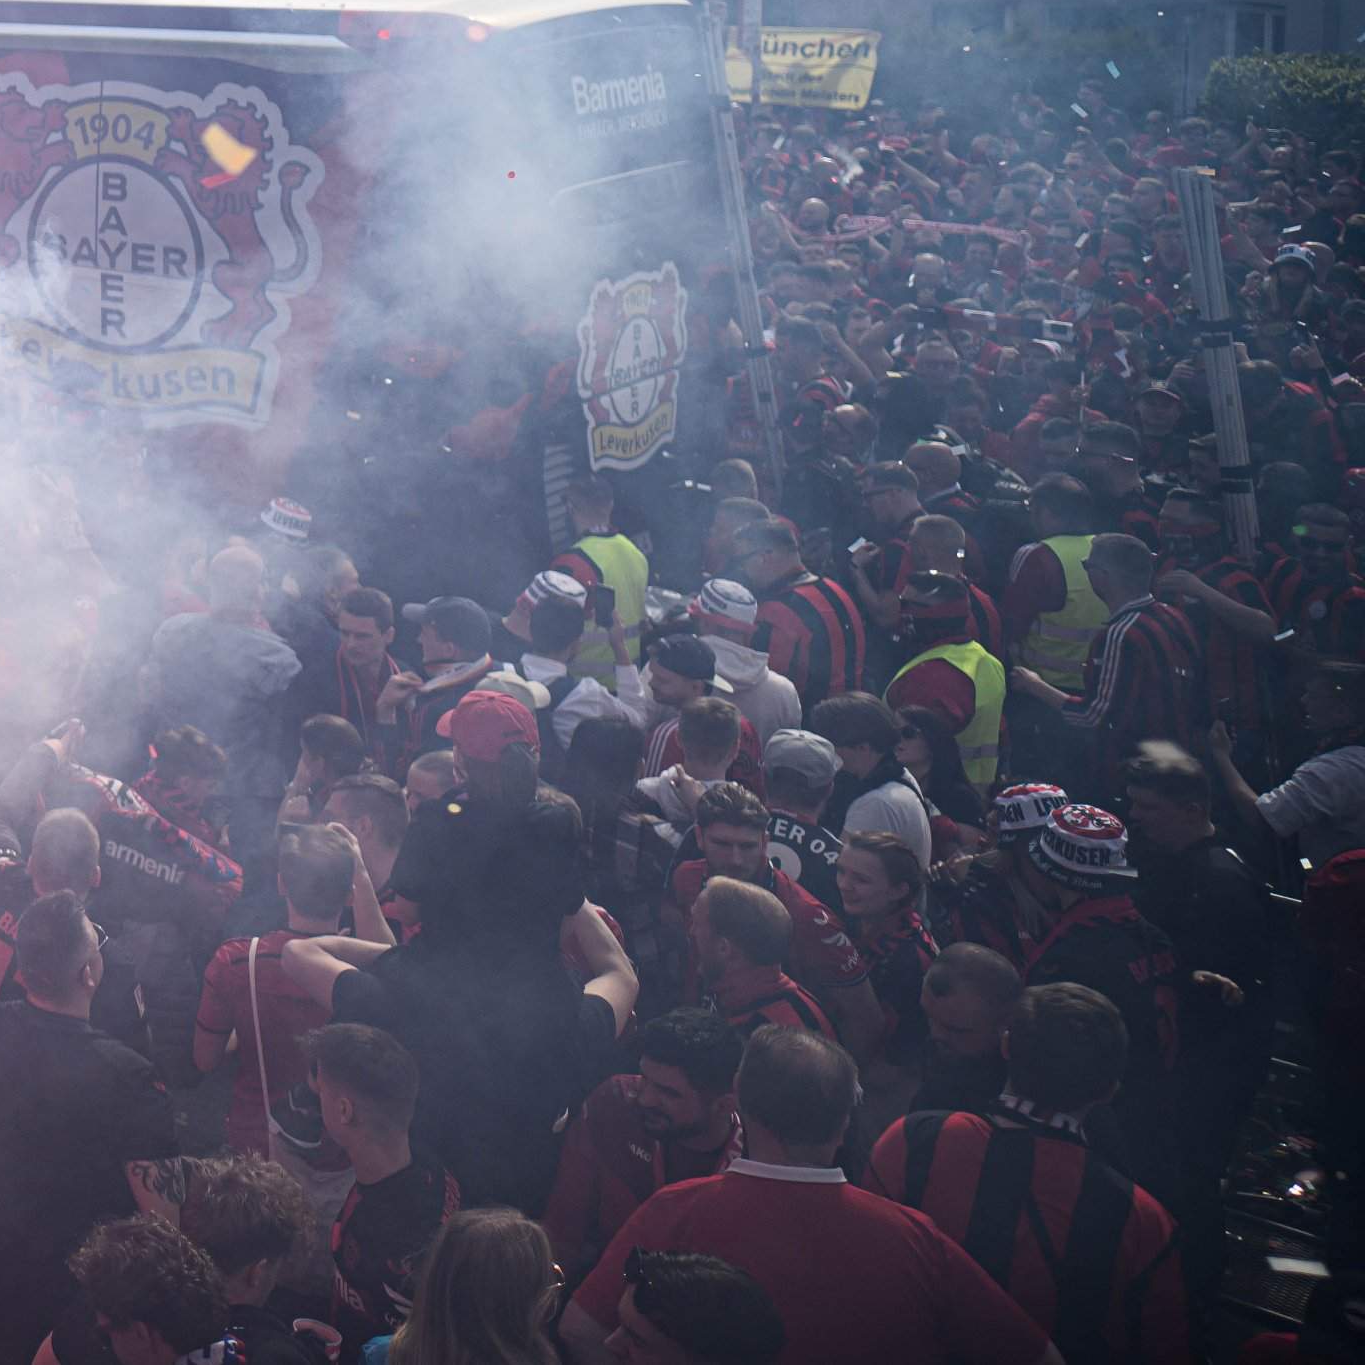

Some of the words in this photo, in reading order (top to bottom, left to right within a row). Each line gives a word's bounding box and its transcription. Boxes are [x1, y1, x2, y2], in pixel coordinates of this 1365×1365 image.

[763, 34, 870, 59] ünchen
[572, 65, 667, 115] Barmenia
[73, 112, 156, 152] 1904
[98, 171, 130, 339] BAYER
[600, 413, 669, 455] Leverkusen
[105, 838, 186, 884] armeni
